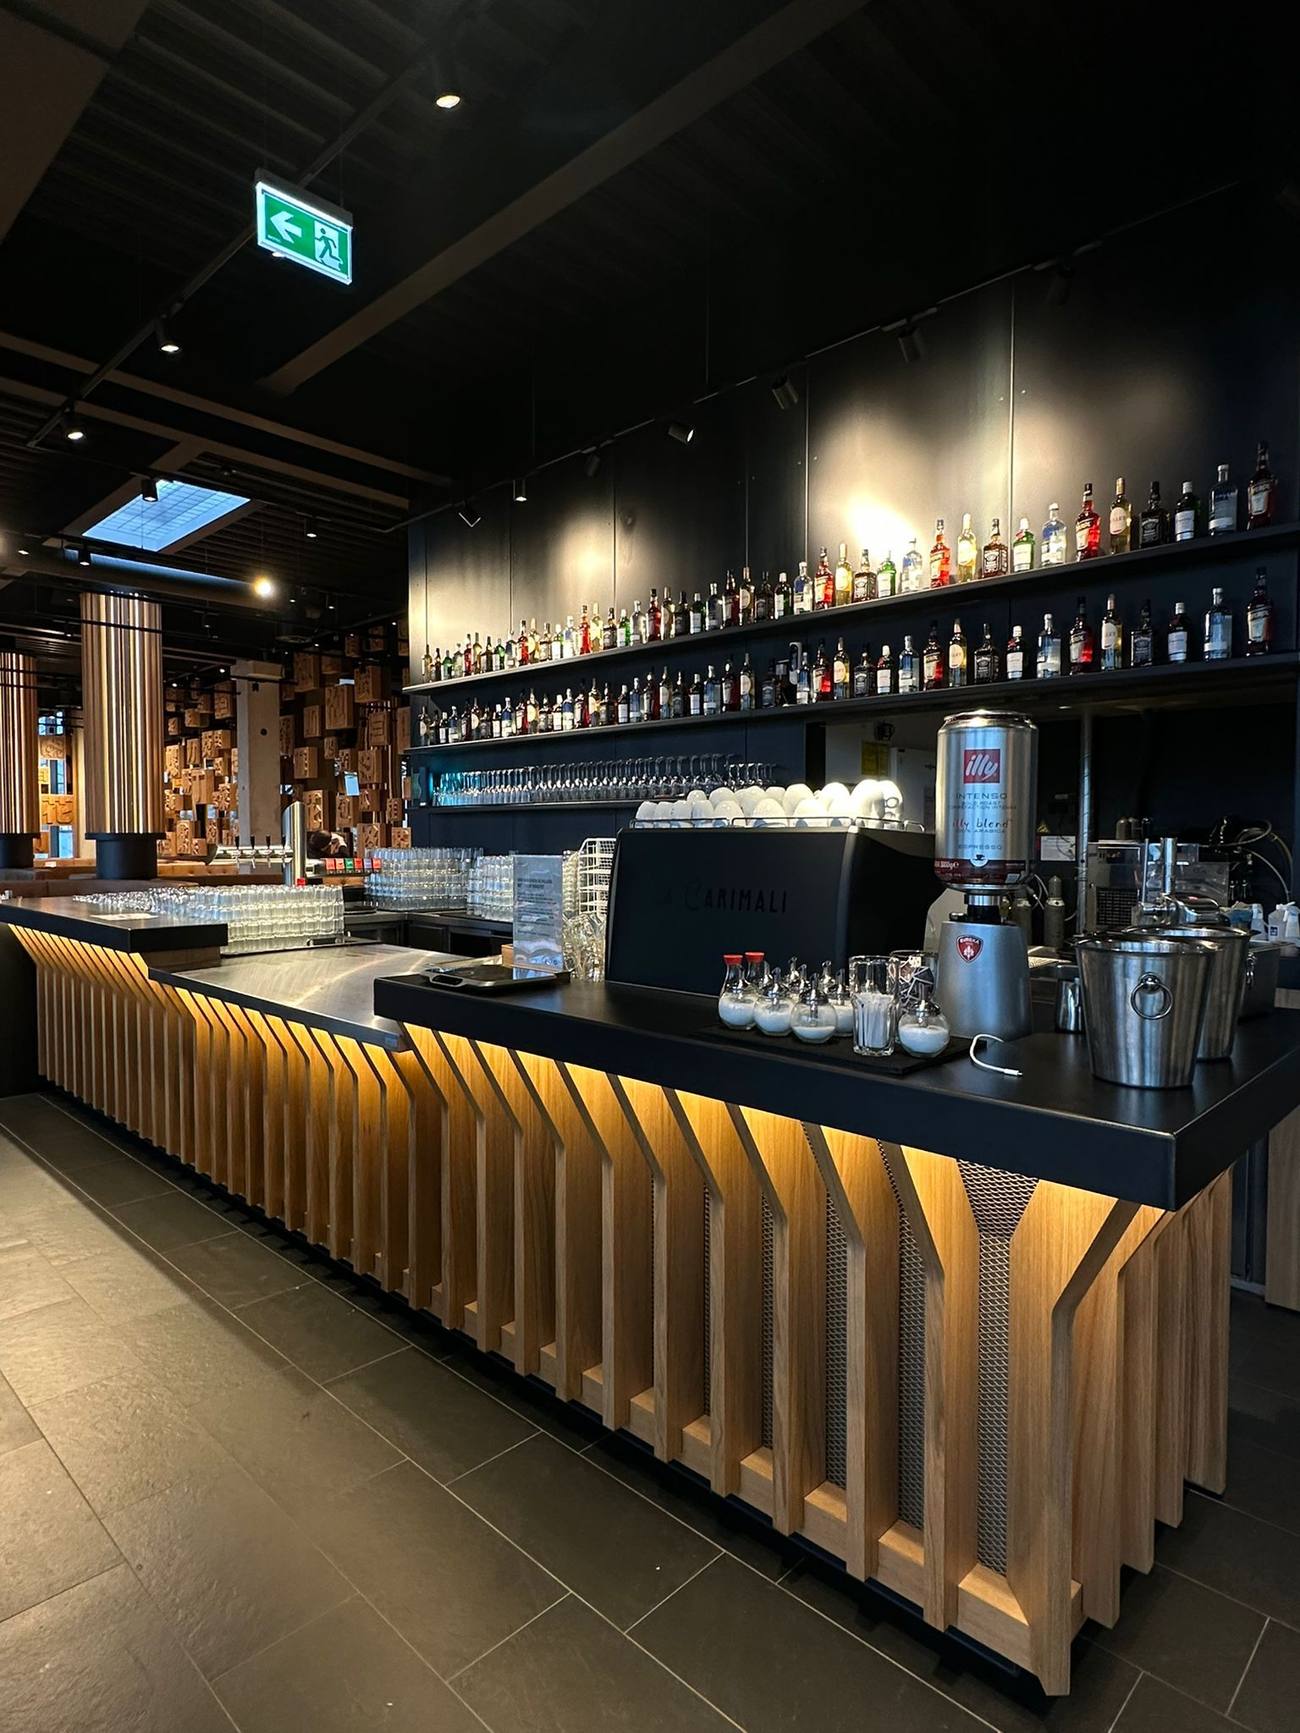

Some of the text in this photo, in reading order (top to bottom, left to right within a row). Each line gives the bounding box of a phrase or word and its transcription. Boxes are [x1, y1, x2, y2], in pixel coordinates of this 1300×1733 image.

[965, 754, 998, 781] illy
[955, 792, 1008, 800] INTENSO
[683, 879, 787, 914] CARIMALI
